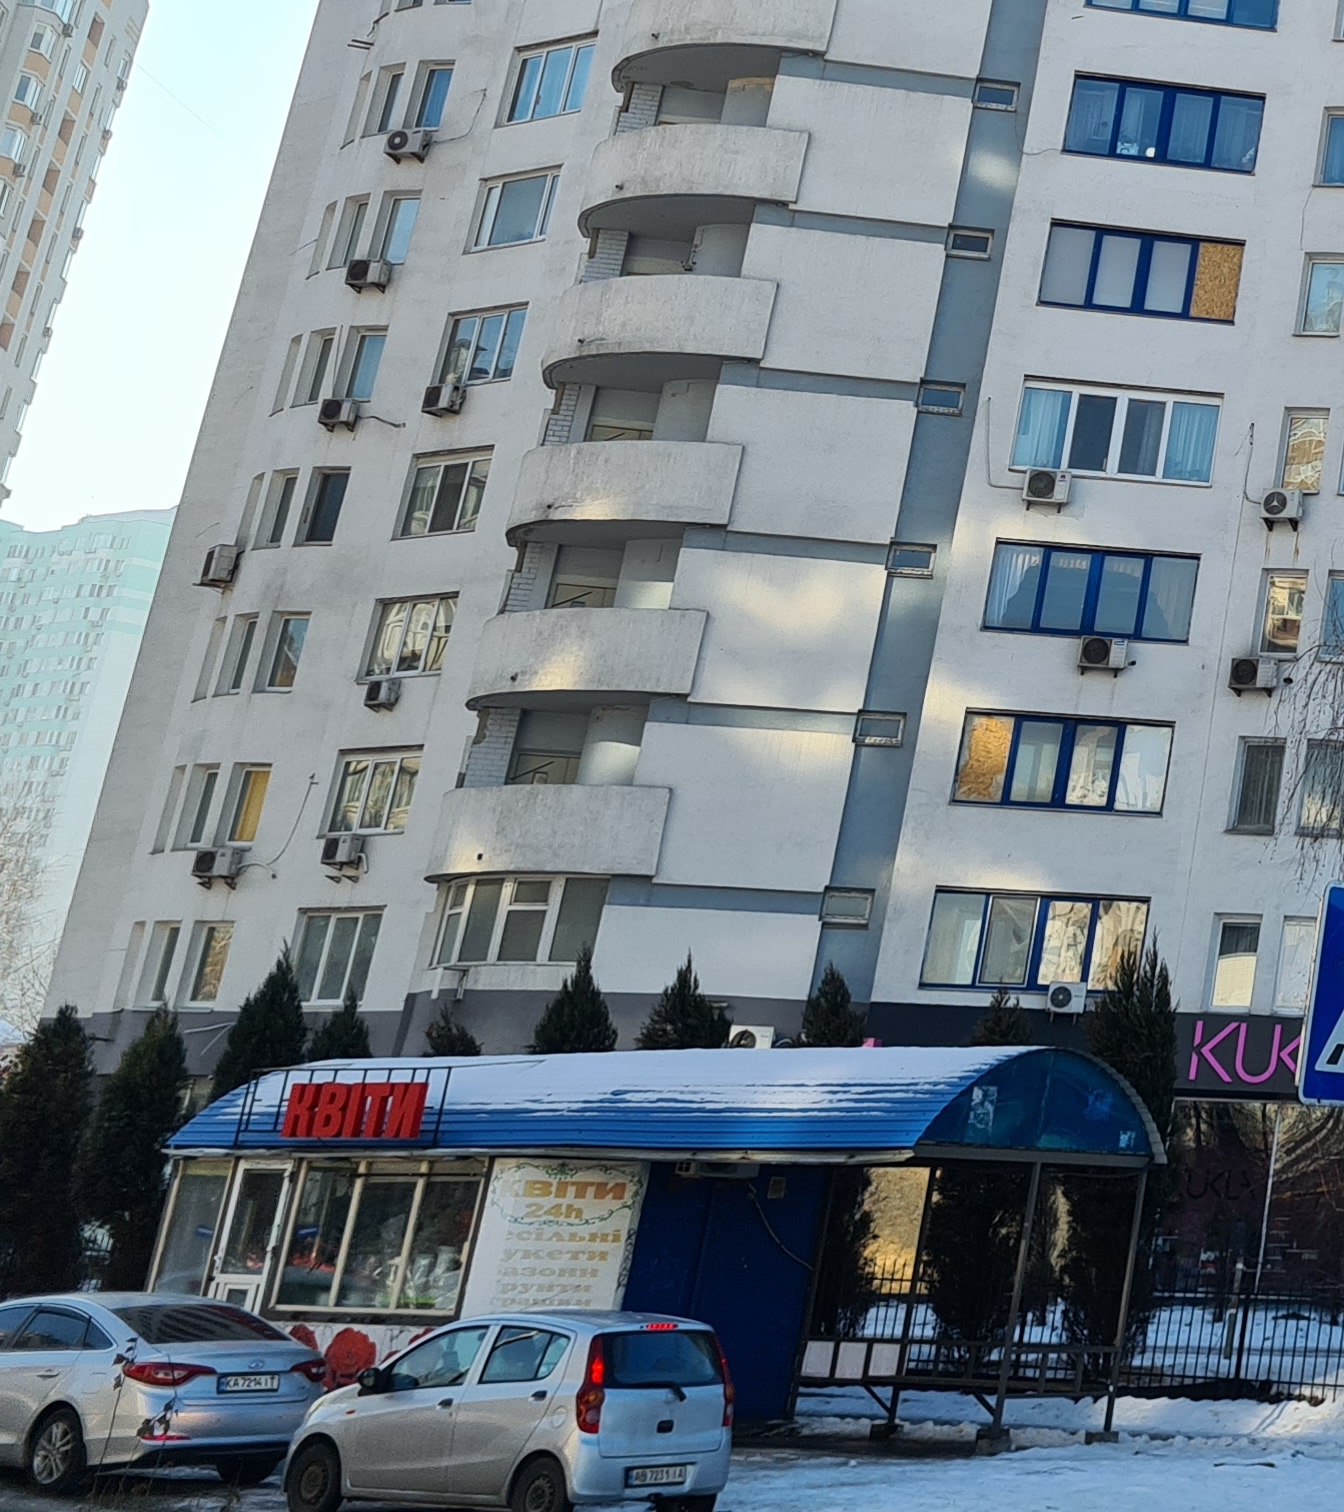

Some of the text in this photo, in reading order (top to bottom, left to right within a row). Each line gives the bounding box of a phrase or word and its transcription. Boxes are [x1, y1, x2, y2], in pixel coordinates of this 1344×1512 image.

[1188, 1020, 1302, 1084] KUK
[280, 1082, 429, 1138] КВІТИ
[524, 1203, 584, 1220] 24h
[505, 1227, 622, 1243] сільні
[500, 1248, 609, 1262] укети
[497, 1266, 600, 1278] азони
